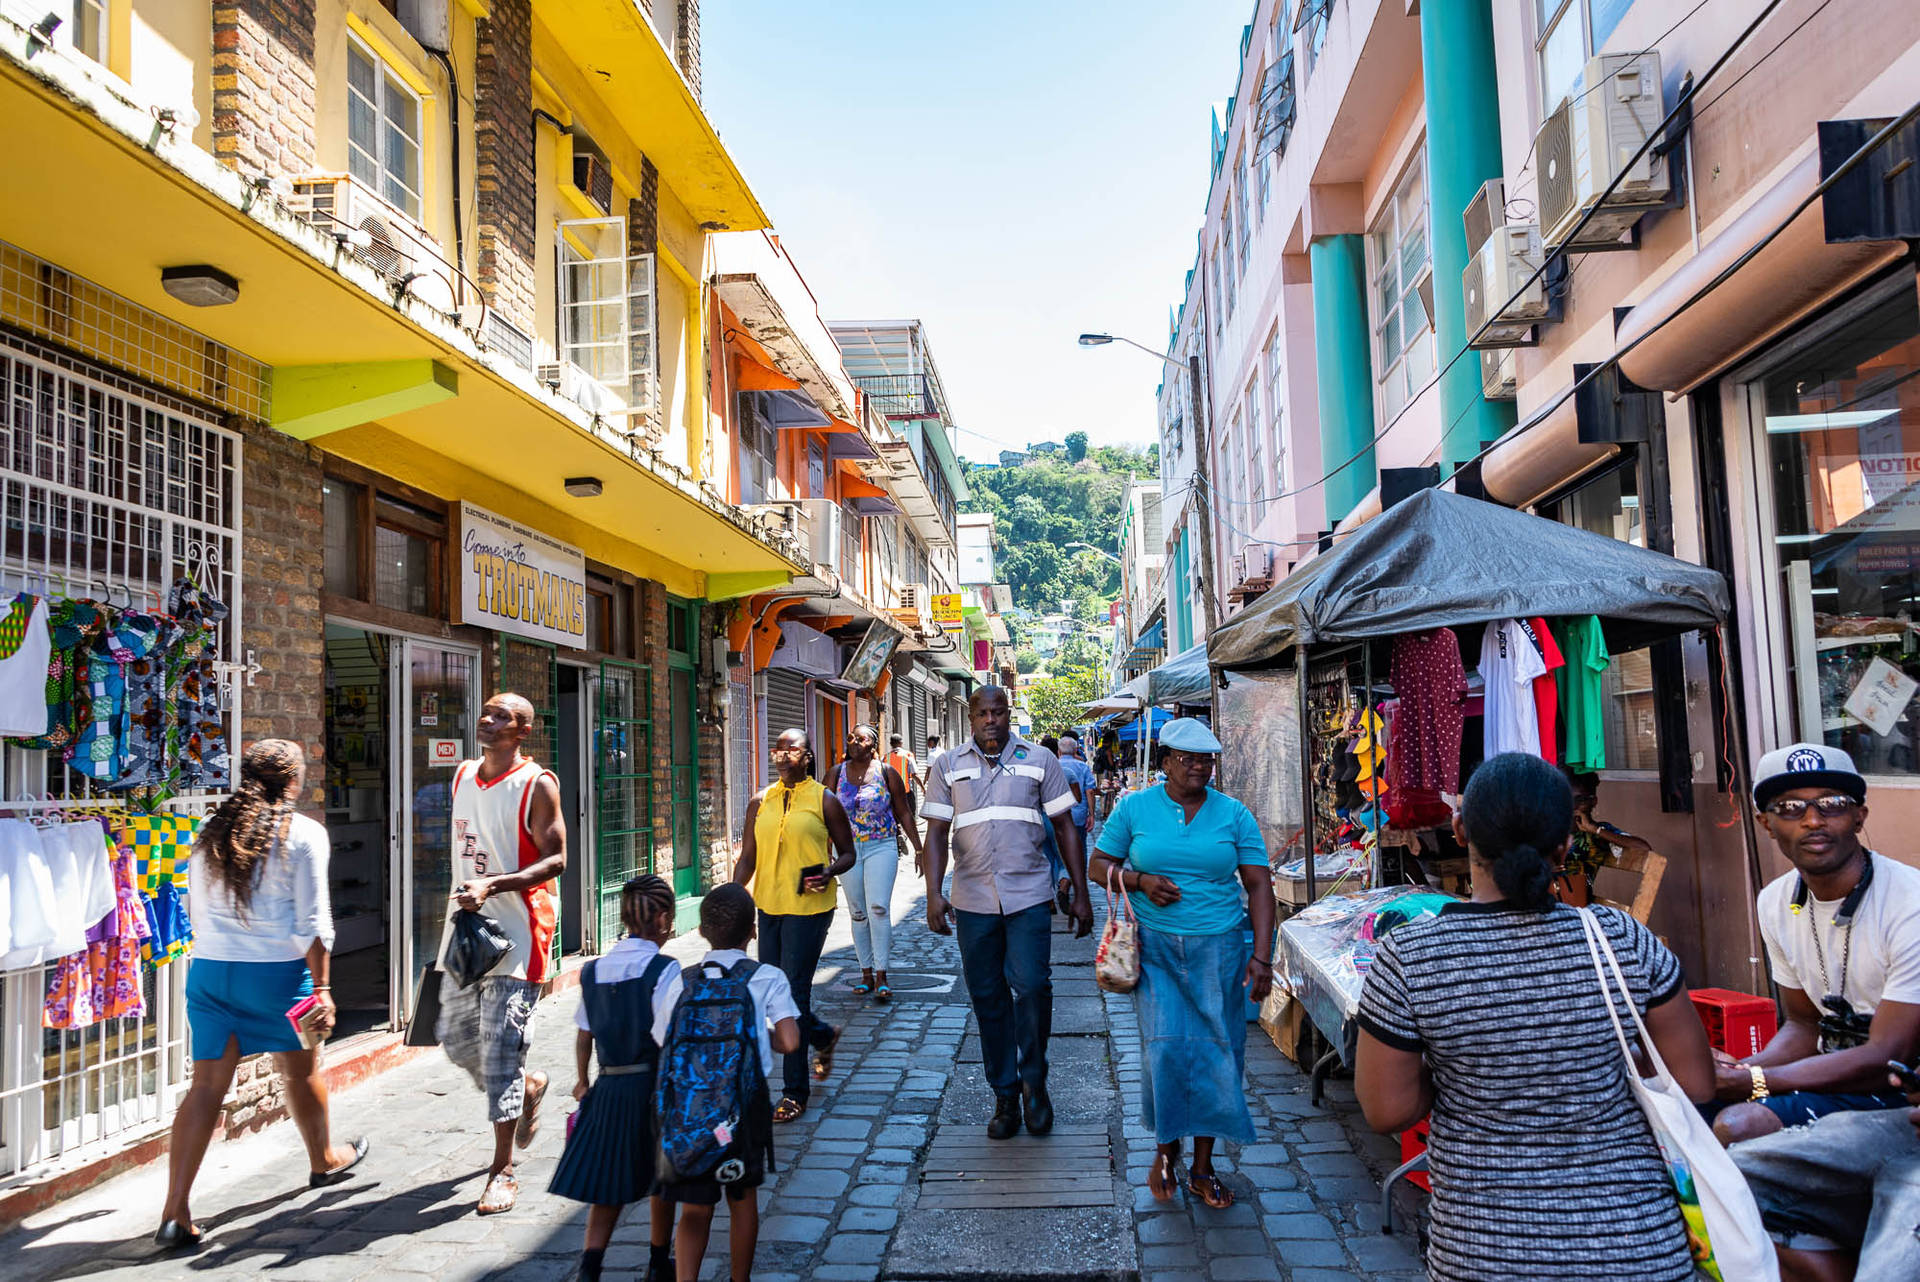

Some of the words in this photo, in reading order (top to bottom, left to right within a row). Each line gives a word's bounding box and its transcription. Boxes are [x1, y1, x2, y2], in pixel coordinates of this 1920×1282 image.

[463, 528, 501, 557] Come
[503, 540, 526, 562] into
[473, 551, 585, 637] TROTMANS
